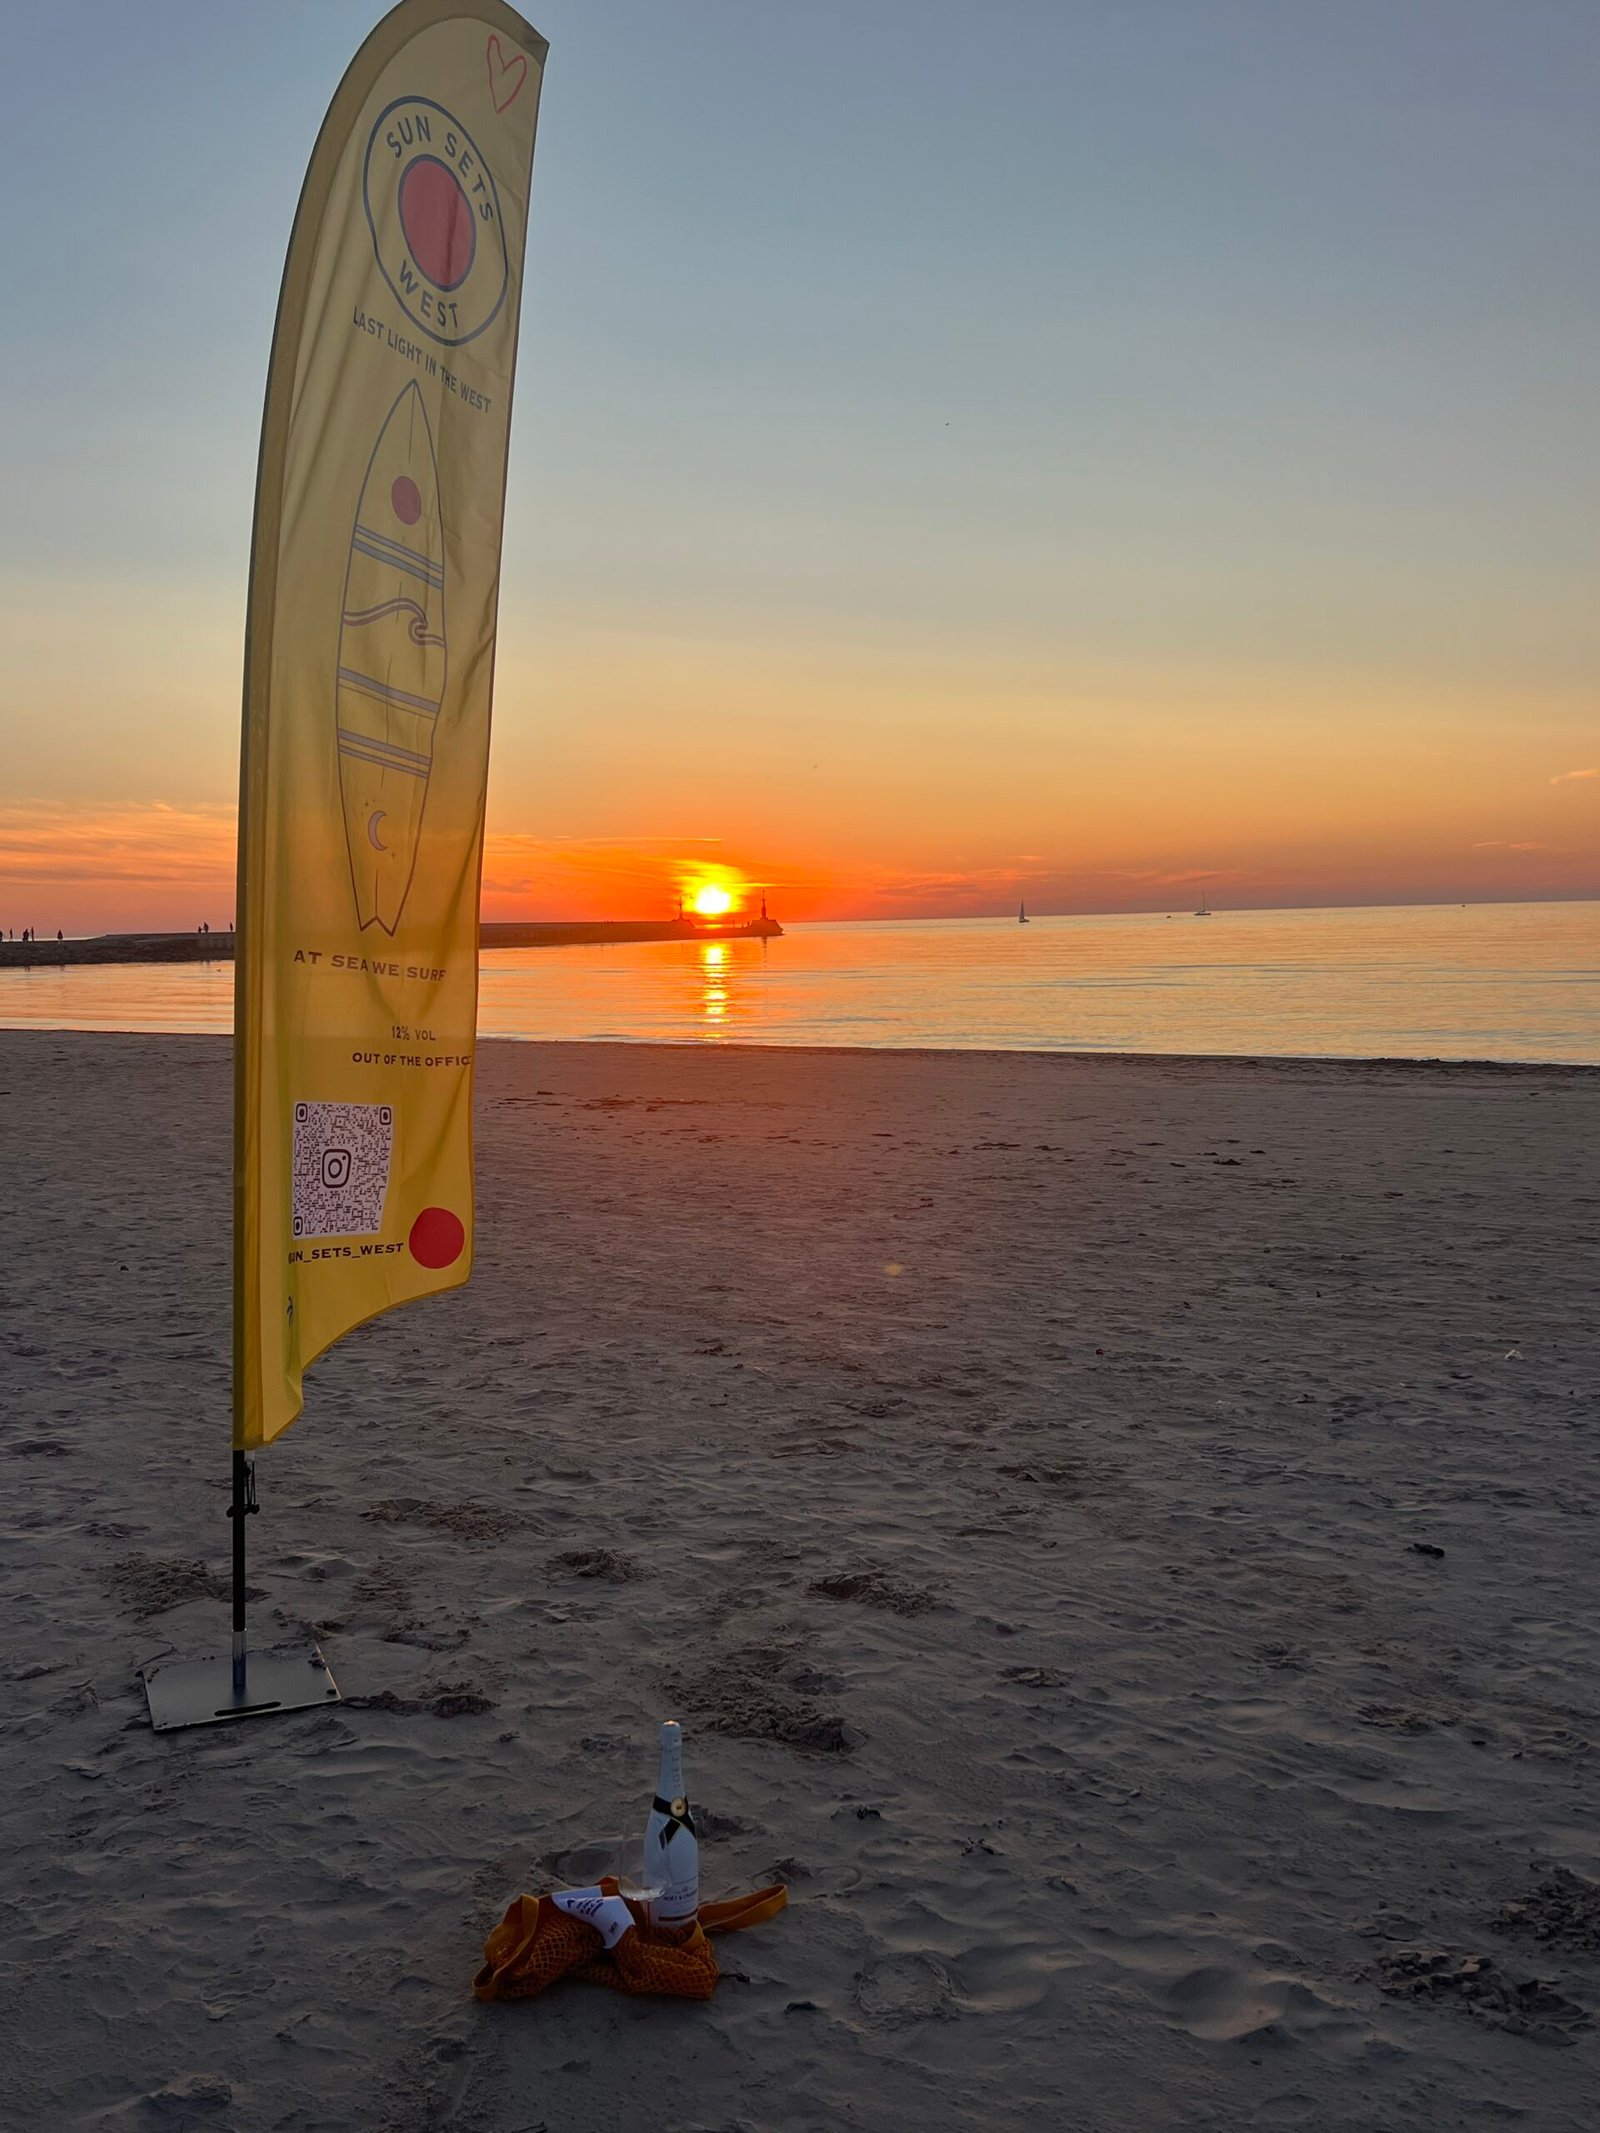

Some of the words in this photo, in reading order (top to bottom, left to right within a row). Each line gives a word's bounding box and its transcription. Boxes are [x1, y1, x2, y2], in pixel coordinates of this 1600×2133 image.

[387, 115, 431, 158] SUN
[445, 132, 493, 221] SETS
[400, 260, 458, 328] WEST
[353, 306, 384, 339] LAST
[388, 329, 422, 364] LIGHT
[425, 354, 437, 376] IN
[440, 366, 457, 392] THE
[461, 382, 491, 413] WEST
[294, 950, 322, 964] AT
[331, 955, 368, 971] SEA
[372, 961, 399, 976] WE
[407, 966, 446, 981] SURF
[392, 1025, 410, 1040] 12%
[415, 1029, 436, 1041] VOL
[352, 1052, 380, 1064] OUT
[384, 1055, 396, 1065] OF
[400, 1055, 421, 1066] THE
[425, 1055, 472, 1067] OFFIC
